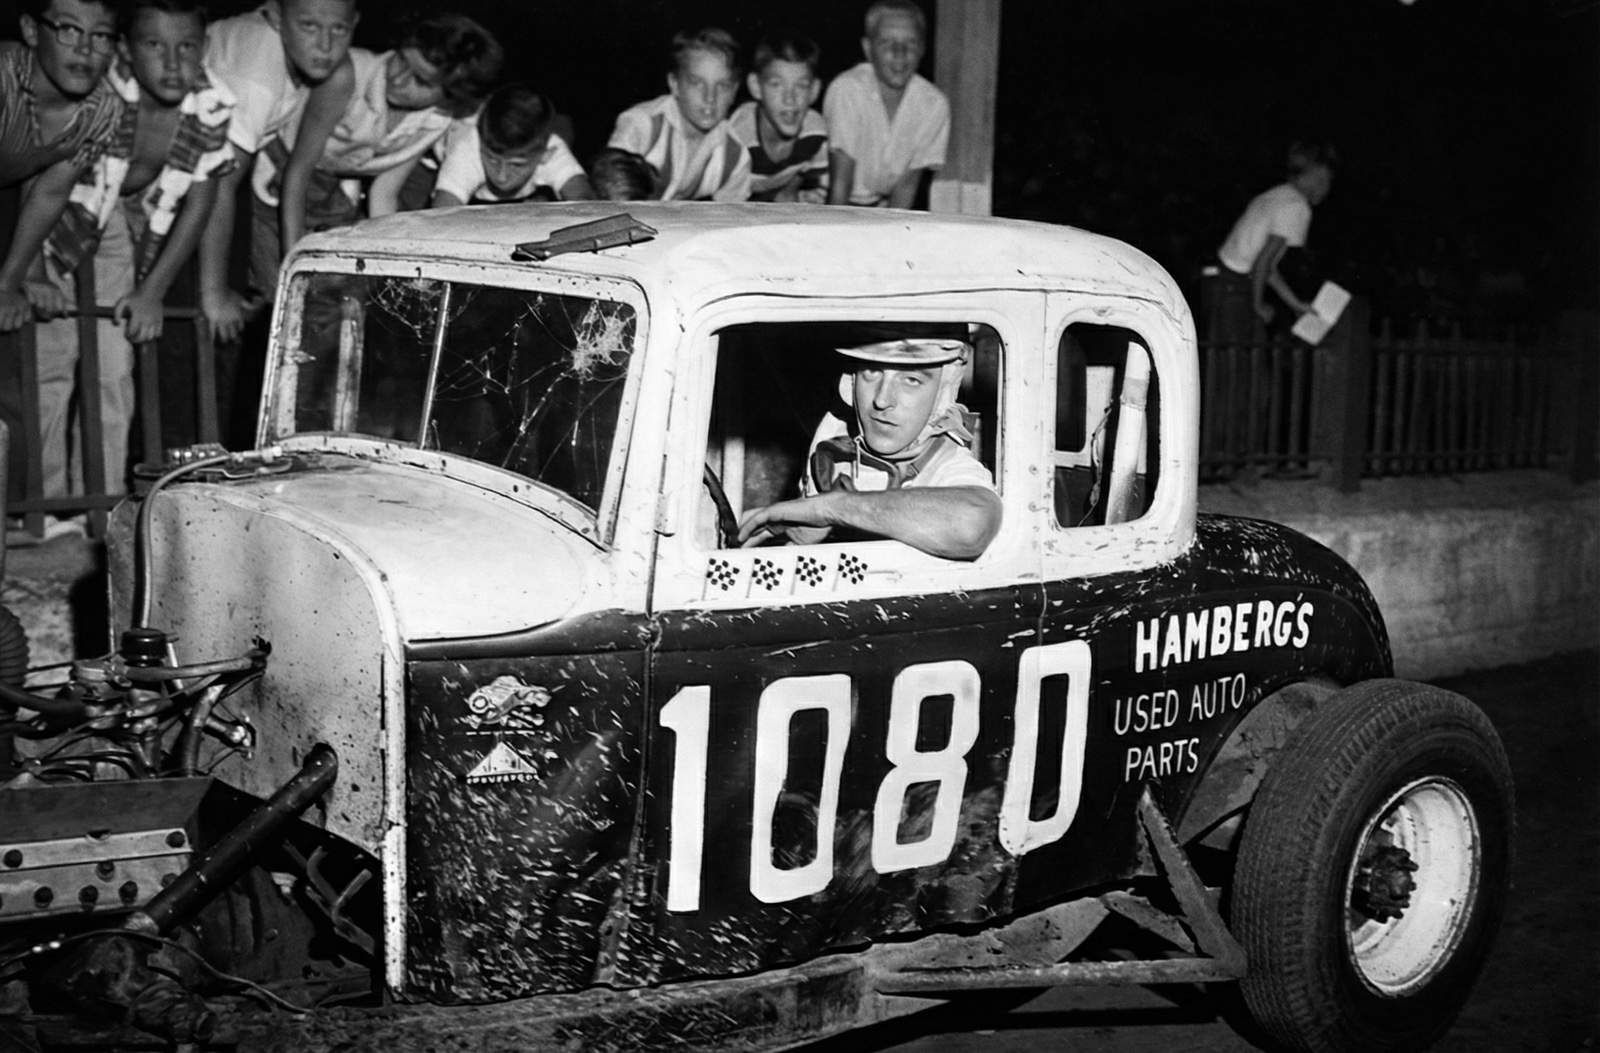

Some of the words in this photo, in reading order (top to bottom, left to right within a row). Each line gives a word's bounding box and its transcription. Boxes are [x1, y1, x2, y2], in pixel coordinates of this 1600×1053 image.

[1135, 593, 1314, 673] HAMBERG'S
[1114, 689, 1179, 735] USED
[1188, 672, 1246, 722] AUTO
[659, 640, 1092, 912] 1080
[1125, 738, 1199, 782] PARTS
